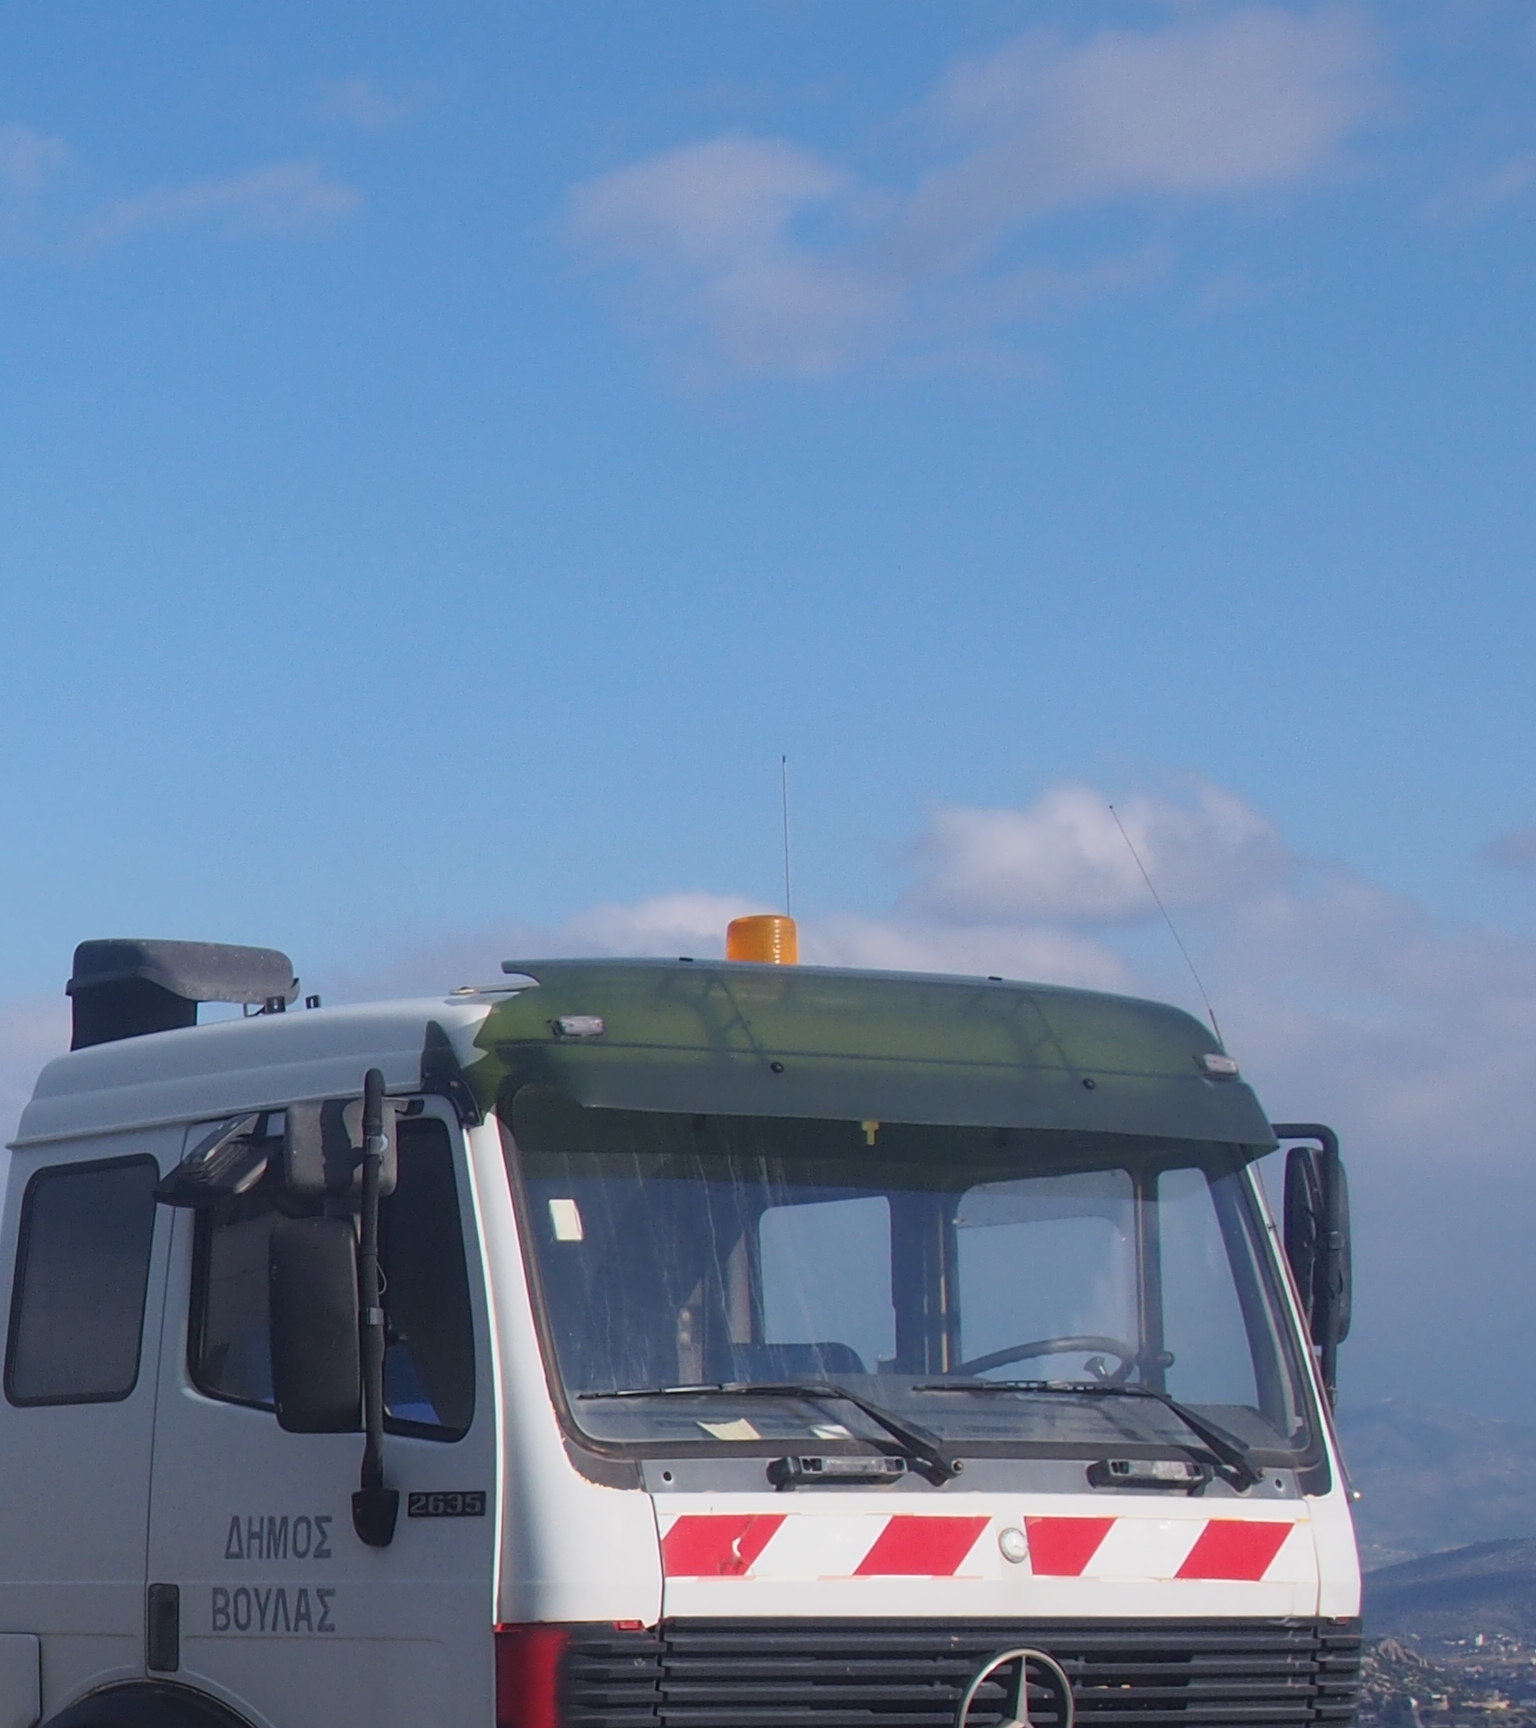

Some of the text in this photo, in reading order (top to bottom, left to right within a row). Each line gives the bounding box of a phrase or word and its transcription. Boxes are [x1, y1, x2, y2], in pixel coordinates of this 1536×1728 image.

[409, 1493, 482, 1514] 2635
[224, 1515, 333, 1560] ΔΗΜΟΣ
[211, 1587, 337, 1633] ΒΟΥΛΑΣ
